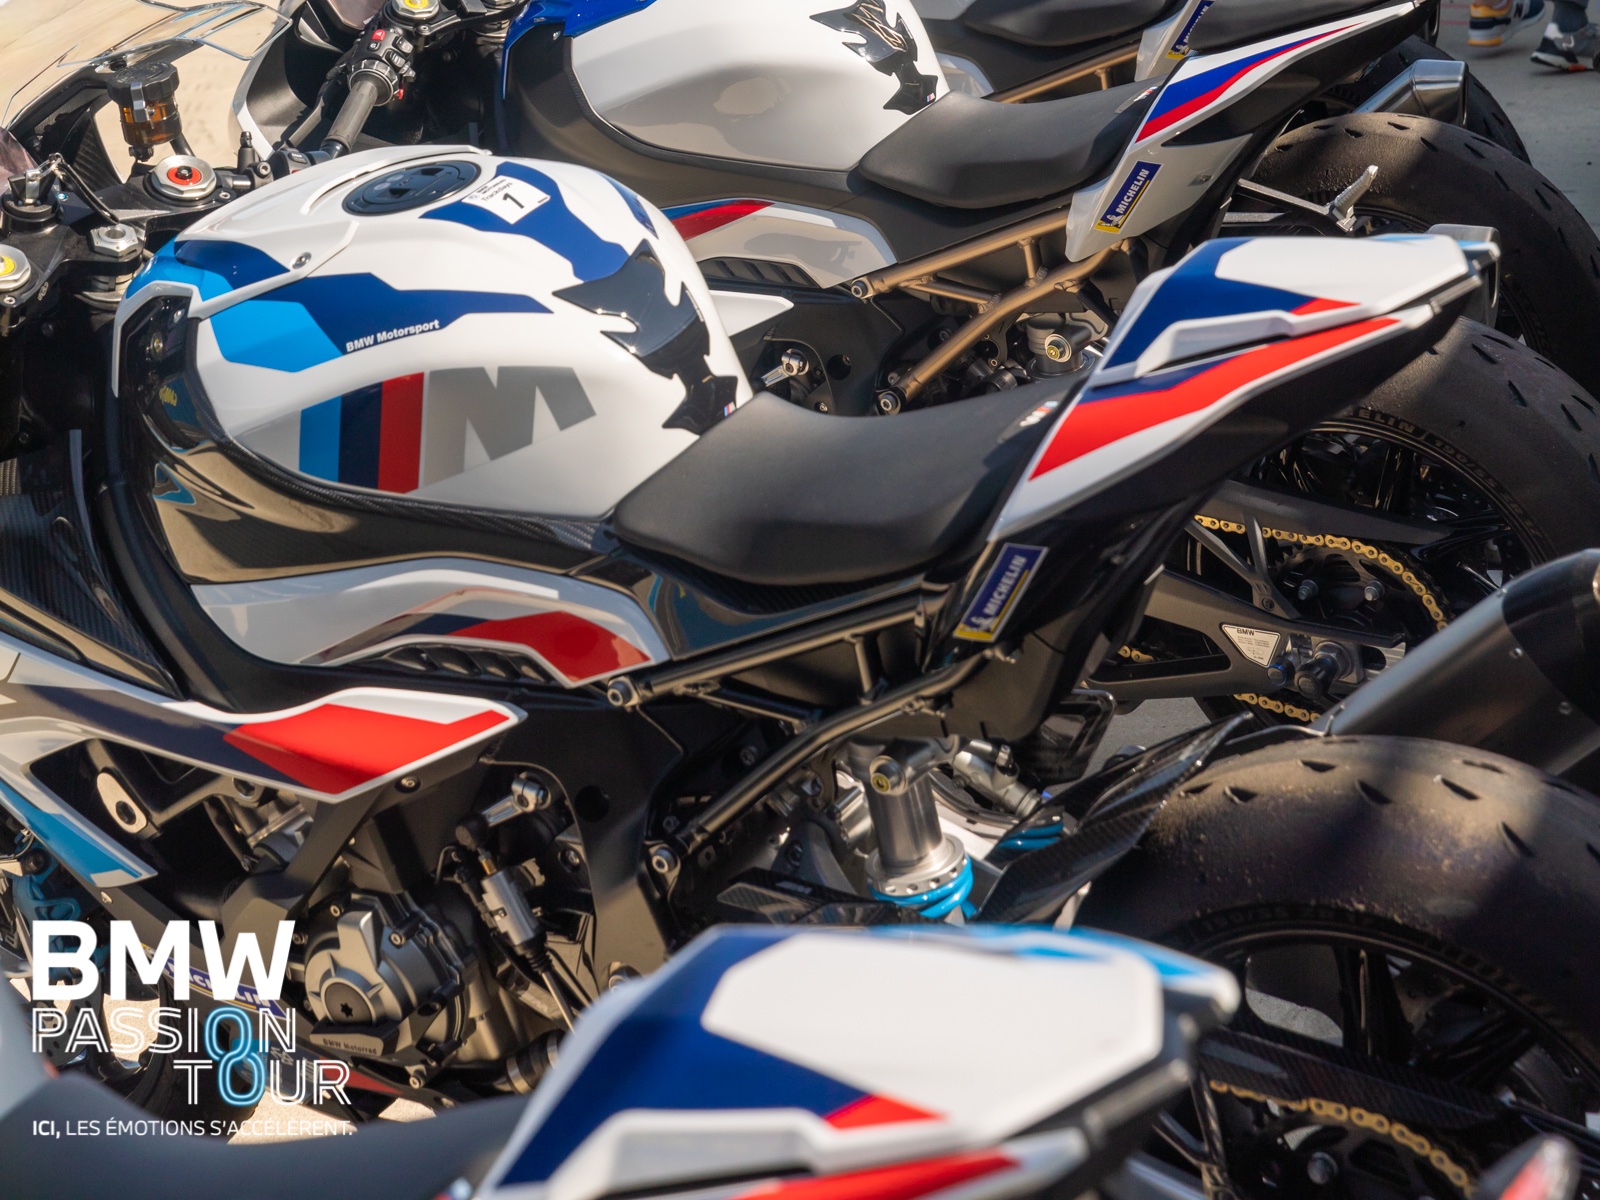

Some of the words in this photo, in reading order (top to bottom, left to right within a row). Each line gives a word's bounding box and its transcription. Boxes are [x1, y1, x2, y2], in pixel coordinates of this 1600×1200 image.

[502, 192, 525, 210] 1
[1115, 168, 1150, 215] MICHELIN
[346, 335, 375, 353] BMW
[376, 319, 440, 344] Motorsport
[982, 554, 1028, 615] MICHELIN
[1236, 627, 1255, 636] BMW
[322, 1038, 342, 1049] BMW
[343, 1042, 377, 1055] Motorrad
